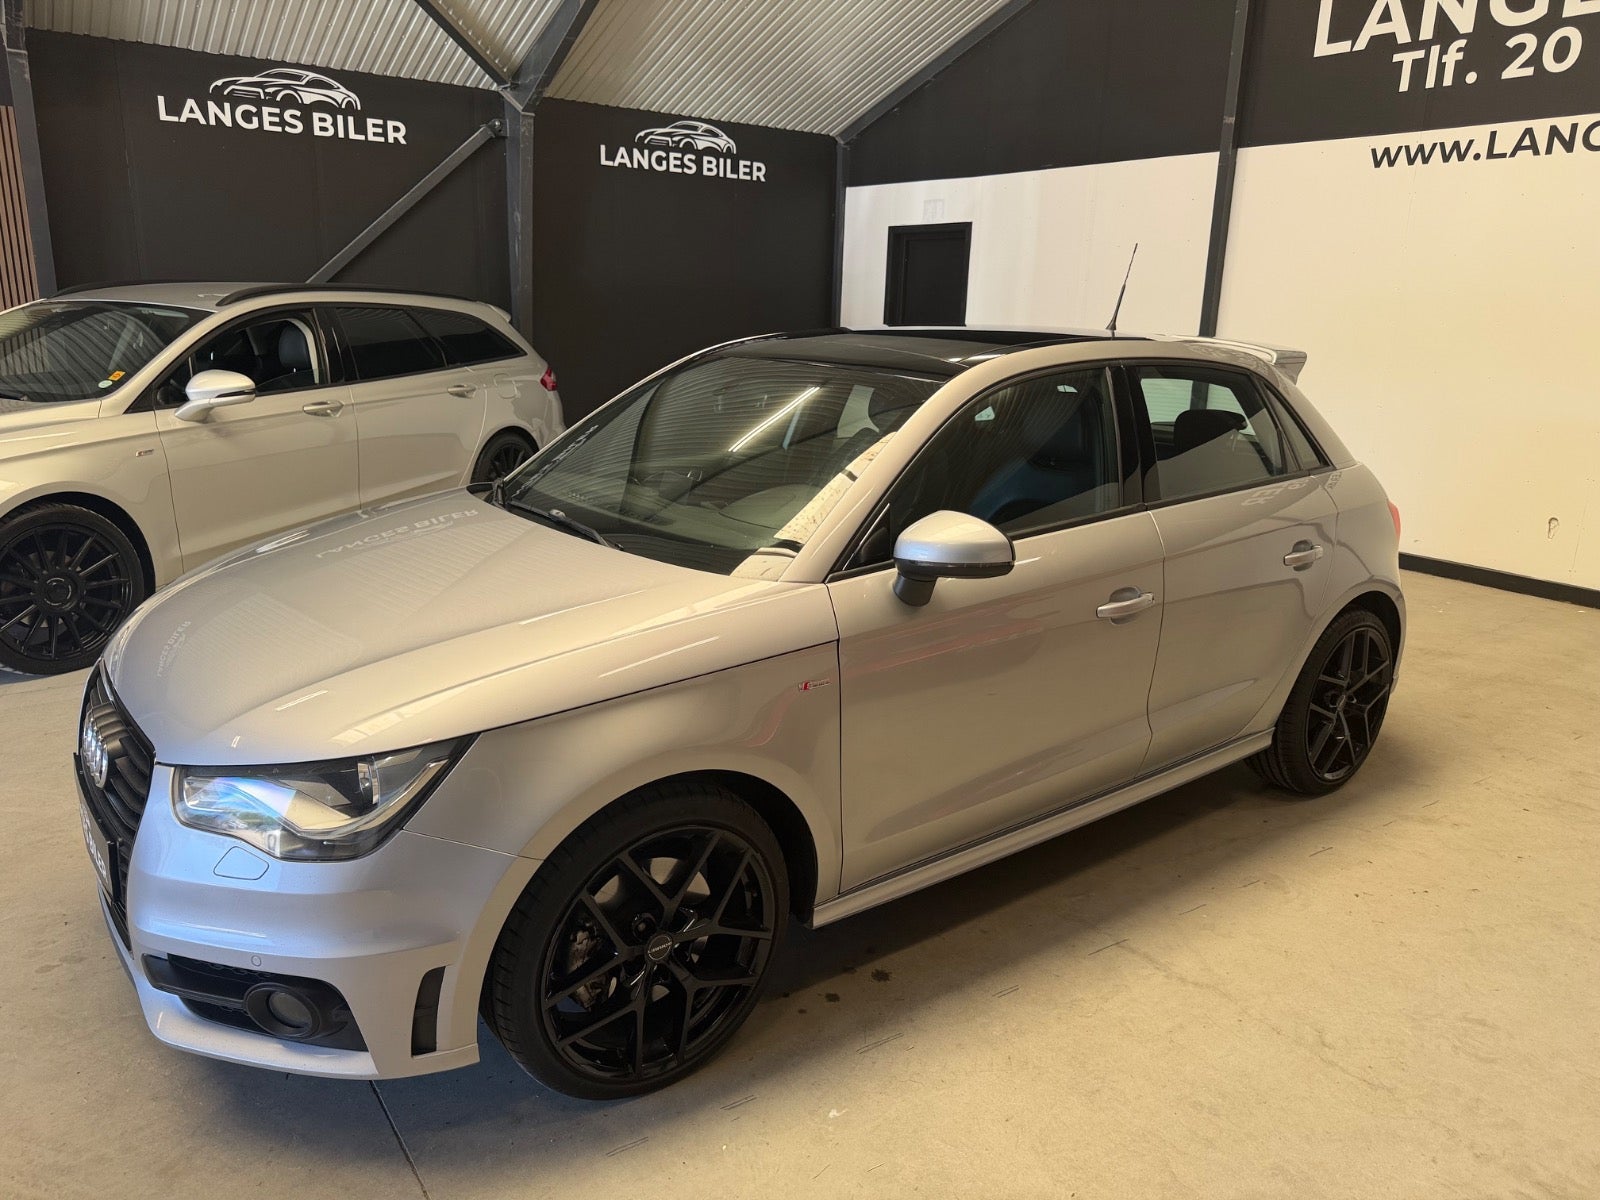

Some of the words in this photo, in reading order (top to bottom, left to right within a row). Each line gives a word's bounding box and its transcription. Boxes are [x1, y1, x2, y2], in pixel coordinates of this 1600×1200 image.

[1392, 39, 1478, 92] Tlf.
[1501, 26, 1583, 80] 20
[157, 95, 304, 134] LANGES
[312, 112, 407, 145] BILER
[600, 144, 697, 175] LANGES
[702, 155, 767, 182] BILER
